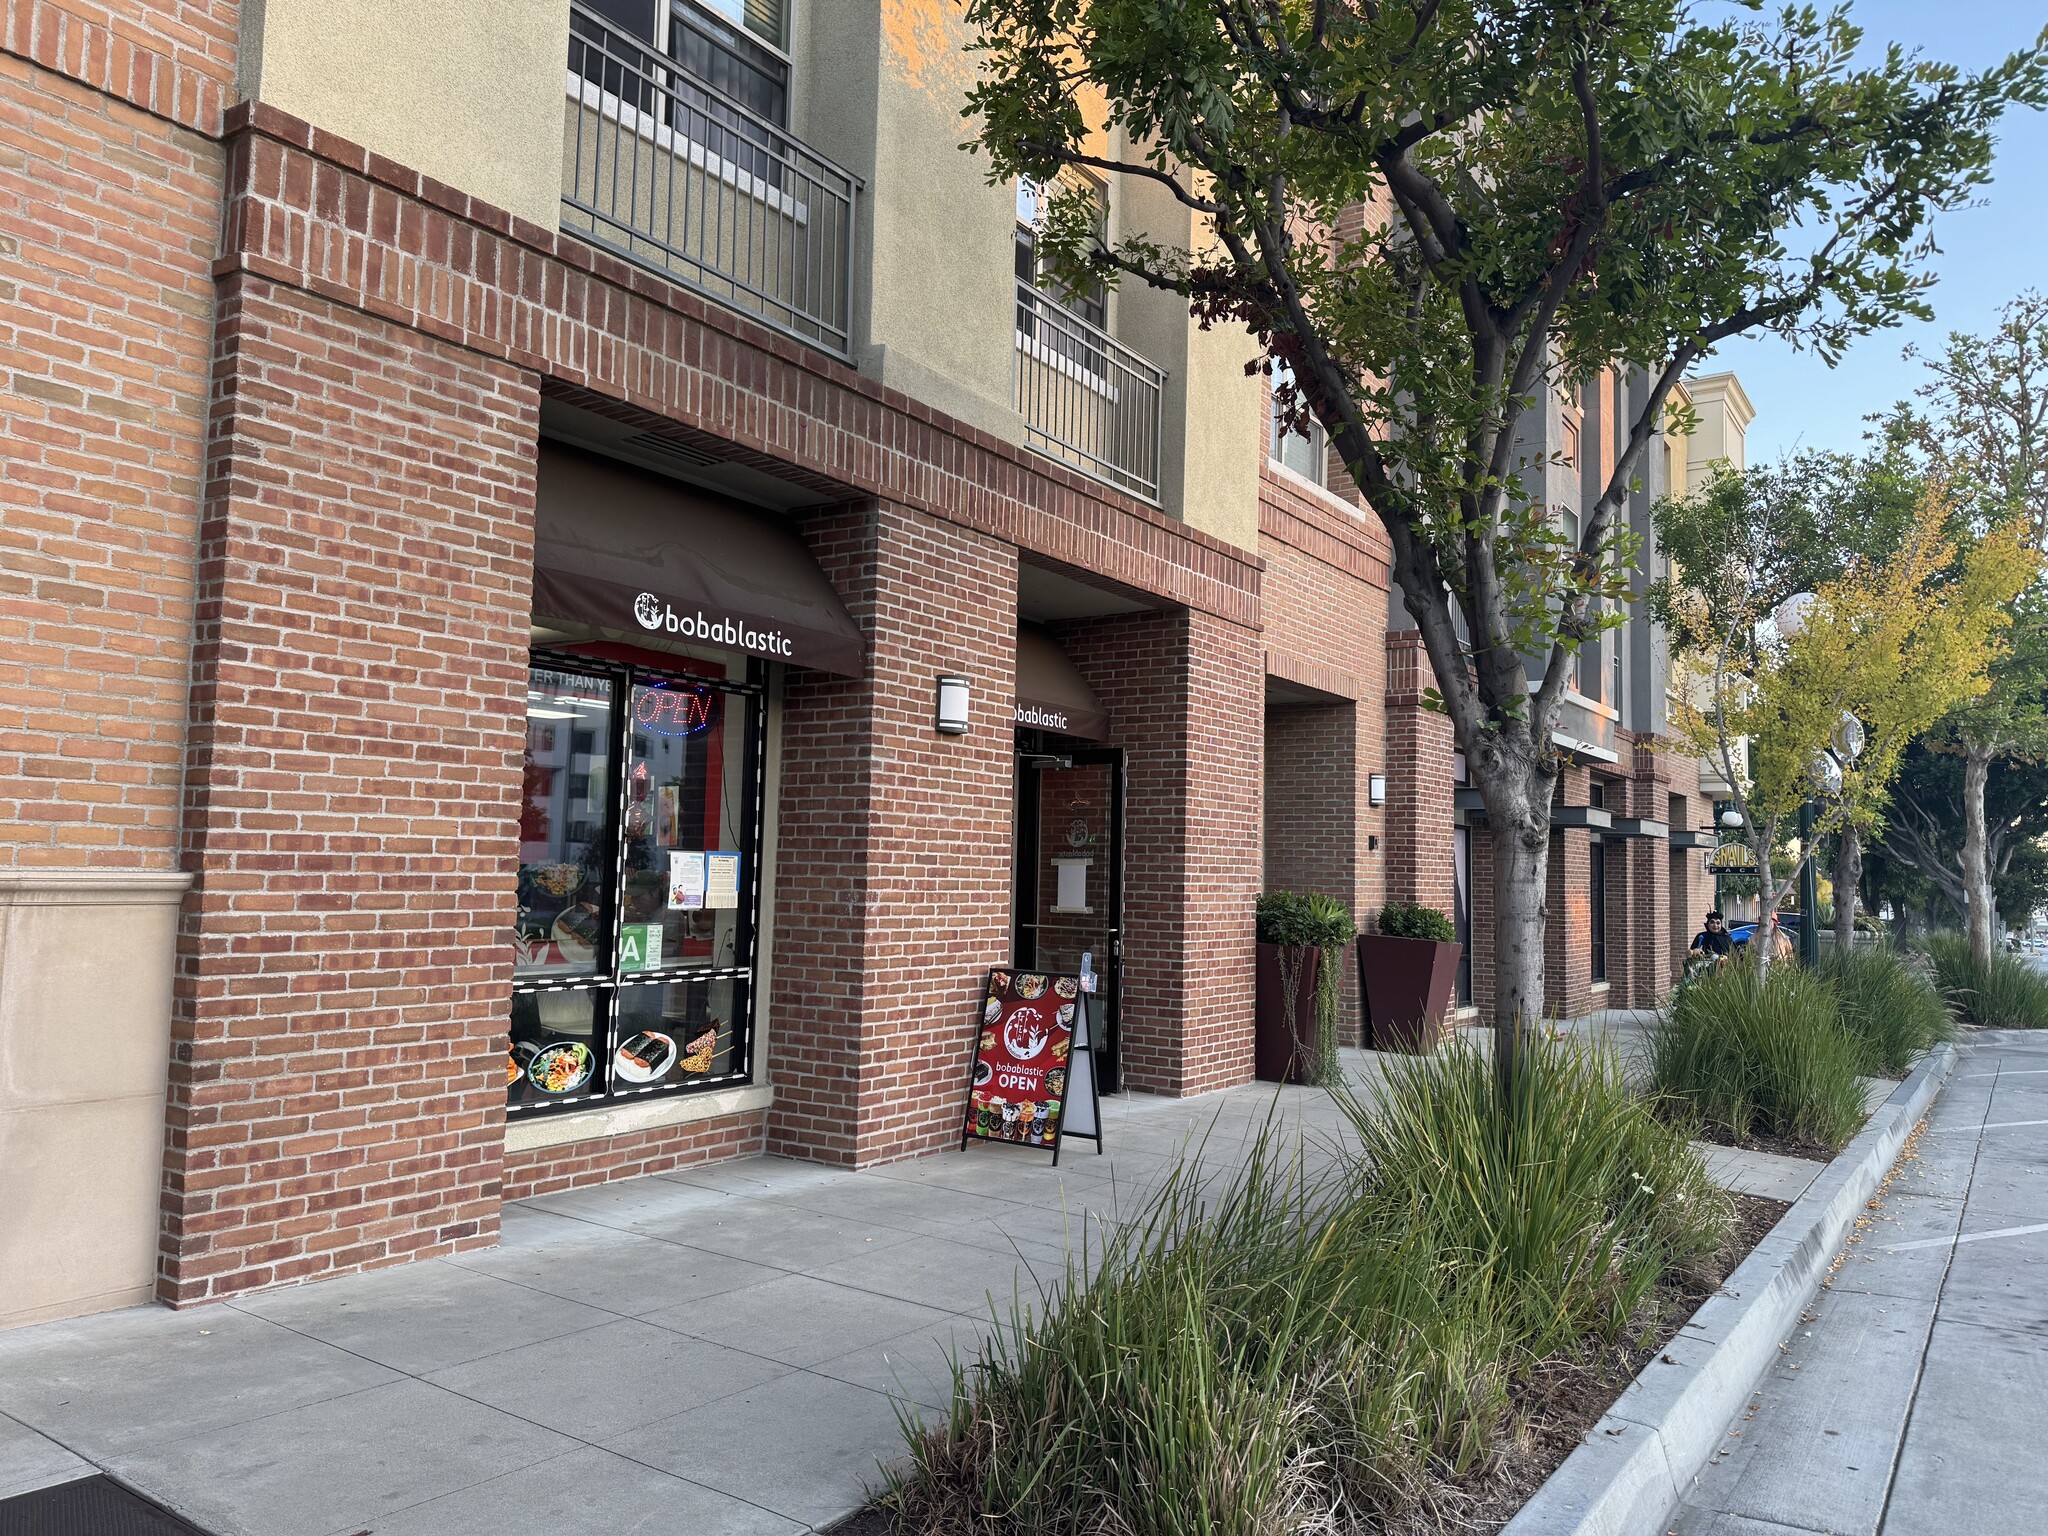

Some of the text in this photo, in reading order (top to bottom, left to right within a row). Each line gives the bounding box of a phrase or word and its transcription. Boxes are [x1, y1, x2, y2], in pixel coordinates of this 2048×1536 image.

[665, 604, 793, 656] bobablastic
[556, 672, 594, 690] THAN
[637, 691, 712, 724] OPEN
[1714, 844, 1757, 866] SNAILS
[620, 935, 640, 962] A
[996, 1061, 1043, 1076] bobablastic
[998, 1073, 1037, 1091] OPEN
